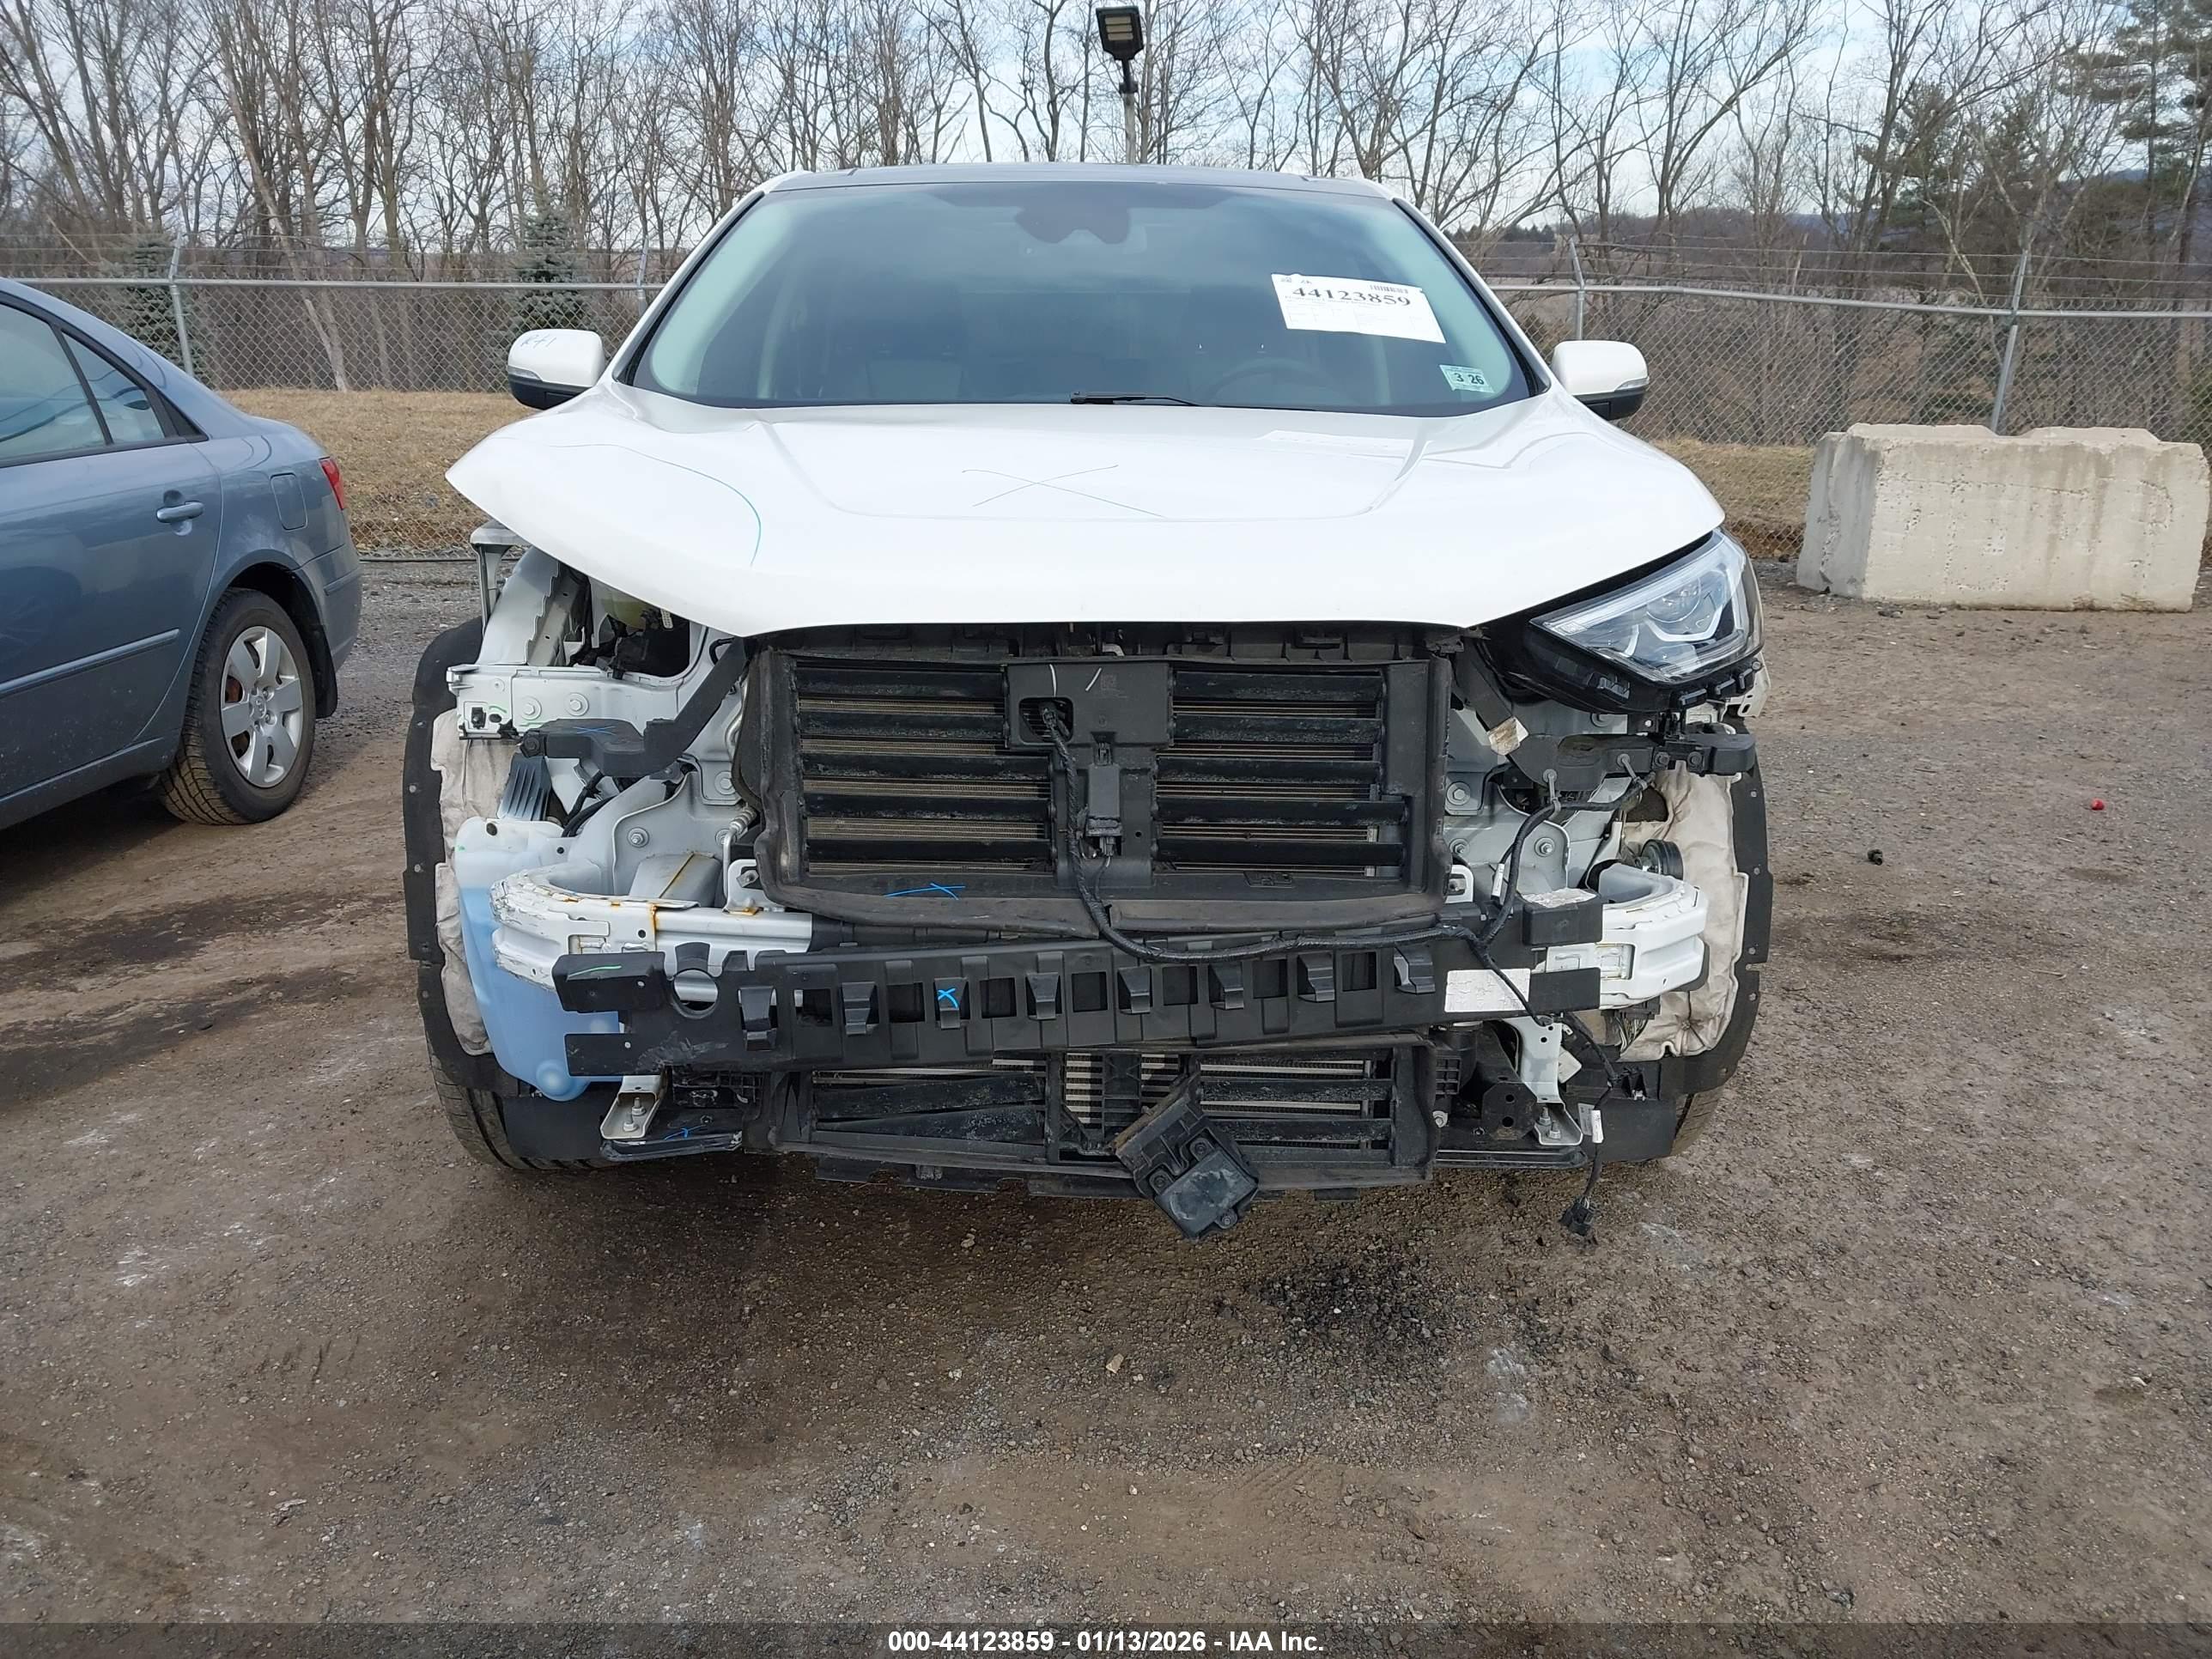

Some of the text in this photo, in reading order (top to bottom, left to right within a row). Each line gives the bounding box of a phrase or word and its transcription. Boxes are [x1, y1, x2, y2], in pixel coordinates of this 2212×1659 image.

[1291, 287, 1412, 307] 44123859
[1454, 372, 1484, 385] 3 26
